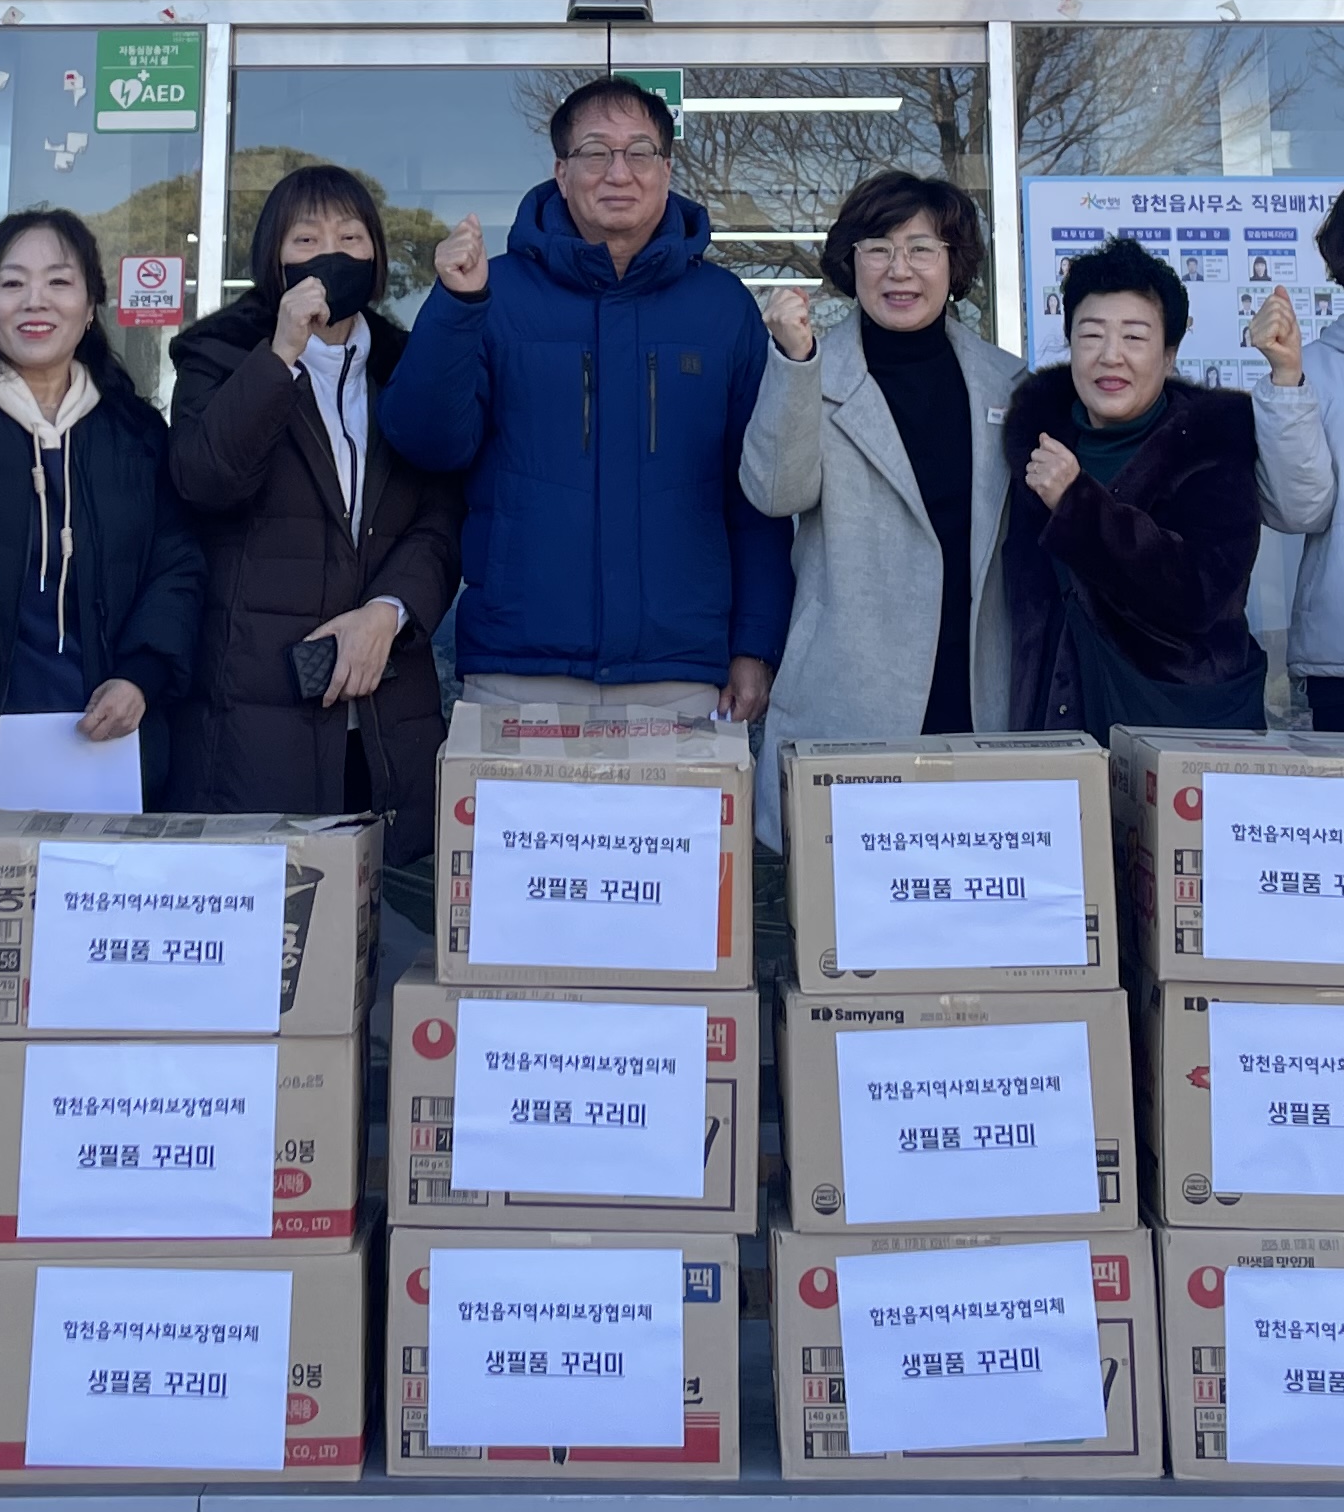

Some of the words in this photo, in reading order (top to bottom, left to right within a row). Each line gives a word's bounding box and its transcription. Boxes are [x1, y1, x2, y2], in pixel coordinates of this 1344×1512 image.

[119, 45, 179, 56] 자동심장충격기
[141, 84, 185, 103] AED
[1131, 194, 1244, 213] 합천읍사무소
[129, 294, 174, 307] 금연구역
[503, 831, 689, 854] 합천읍지역사회보장협의체
[861, 832, 1051, 851] 합천읍지역사회보장협의체
[528, 877, 587, 900] 생필품
[601, 880, 660, 904] 꾸러미
[891, 879, 951, 901] 생필품
[965, 877, 1025, 901] 꾸러미
[1260, 871, 1321, 896] 생필품
[65, 892, 254, 913] 합천읍지역사회보장협의체
[89, 939, 149, 962] 생필품
[164, 941, 222, 963] 꾸러미
[835, 1007, 905, 1024] Samyang
[486, 1052, 675, 1075] 합천읍지역사회보장협의체
[868, 1076, 1060, 1100] 합천읍지역사회보장협의체
[54, 1097, 245, 1117] 합천읍지역사회보장협의체
[512, 1099, 571, 1124] 생필품
[586, 1103, 645, 1126] 꾸러미
[1269, 1102, 1330, 1127] 생필품
[899, 1128, 960, 1152] 생필품
[974, 1124, 1034, 1147] 꾸러미
[78, 1145, 139, 1168] 생필품
[154, 1146, 214, 1168] 꾸러미
[312, 1217, 331, 1231] LTD
[459, 1302, 651, 1323] 합천읍지역사회보장협의체
[870, 1298, 1064, 1326] 합천읍지역사회보장협의체
[64, 1321, 258, 1343] 합천읍지역사회보장협의체
[486, 1351, 547, 1376] 생필품
[562, 1352, 622, 1376] 꾸러미
[903, 1353, 964, 1378] 생필품
[978, 1348, 1040, 1373] 꾸러미
[89, 1370, 151, 1396] 생필품
[165, 1373, 226, 1397] 꾸러미
[319, 1444, 339, 1458] LTD
